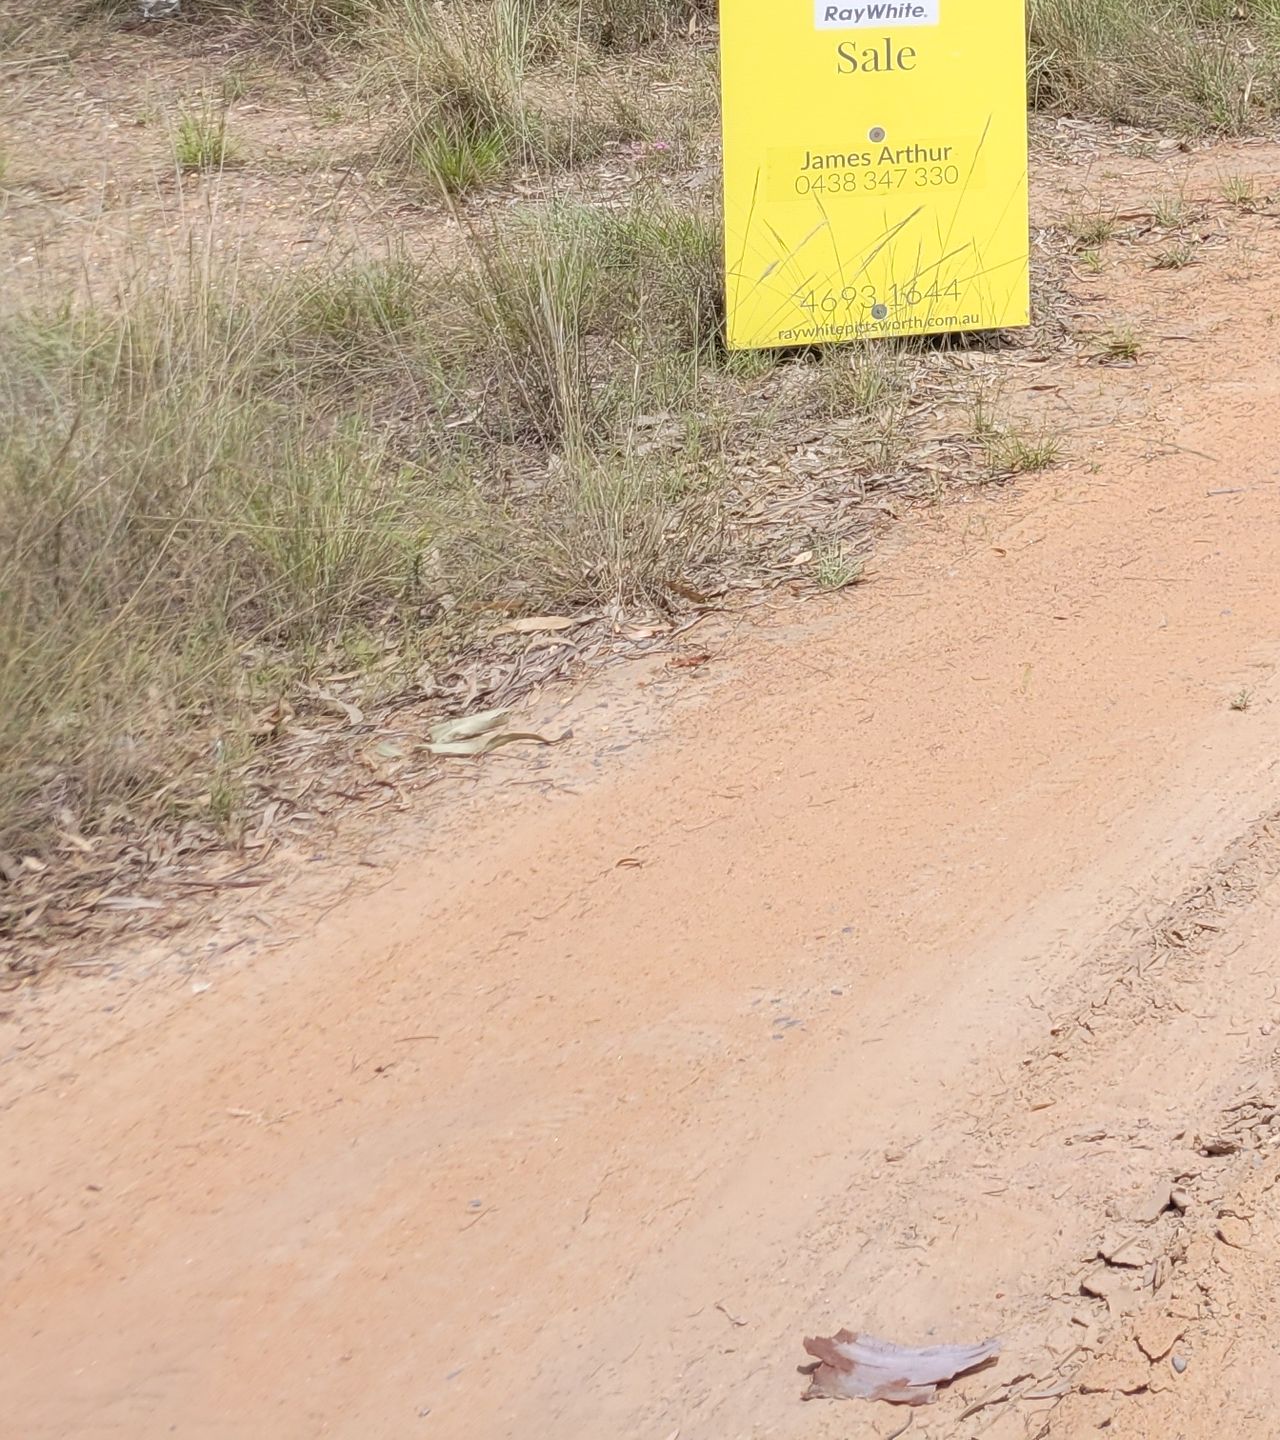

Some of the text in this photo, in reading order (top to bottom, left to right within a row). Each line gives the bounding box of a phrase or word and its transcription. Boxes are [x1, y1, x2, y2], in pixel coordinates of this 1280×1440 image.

[837, 37, 917, 75] Sale
[800, 144, 952, 171] James Arthur
[795, 165, 959, 195] 0438 347 330
[800, 279, 962, 312] 4693 1644
